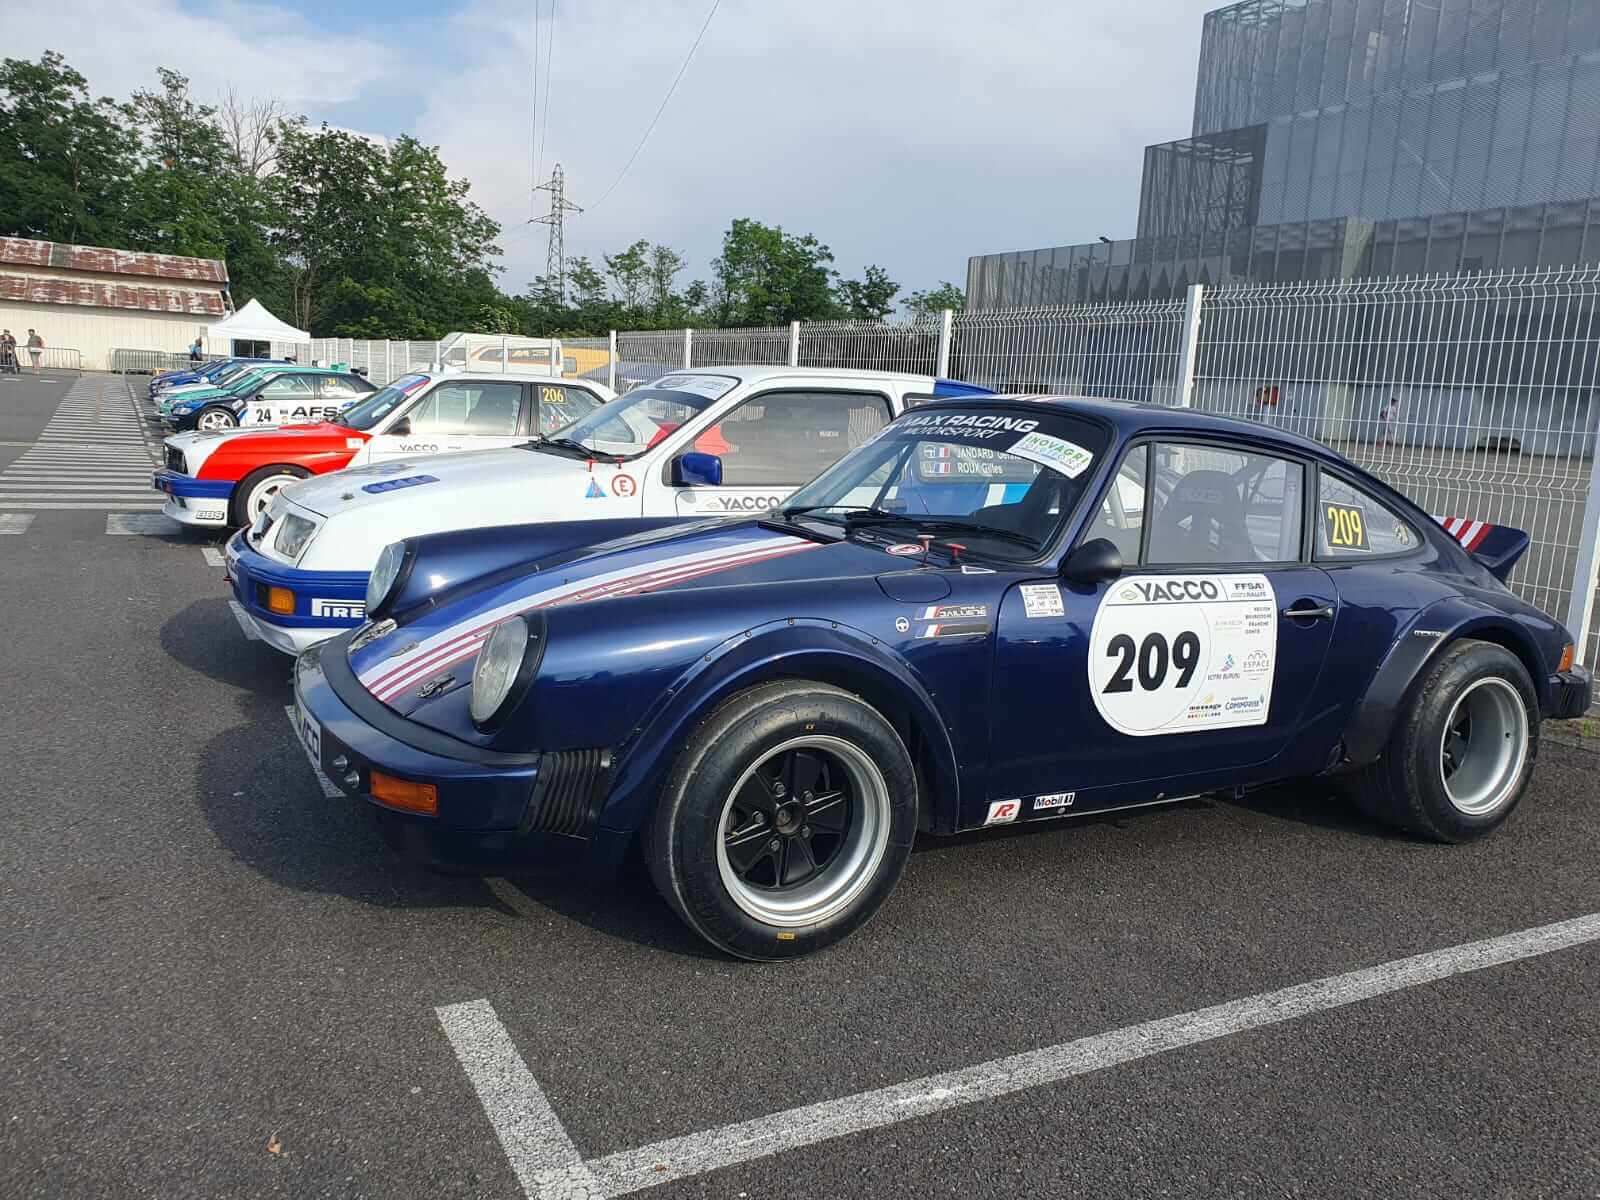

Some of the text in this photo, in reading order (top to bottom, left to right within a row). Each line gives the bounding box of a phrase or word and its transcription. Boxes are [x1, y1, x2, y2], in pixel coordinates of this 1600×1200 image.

[542, 387, 564, 403] 206
[255, 407, 272, 422] 24
[291, 406, 337, 417] AFS
[944, 415, 1039, 433] RACING
[903, 427, 1006, 439] MOTORSPORT
[399, 443, 439, 452] YACCO
[1024, 435, 1089, 464] INOVAGRI
[957, 462, 1003, 475] ROUX Gilles
[619, 479, 629, 492] E
[718, 496, 780, 511] YACCO
[195, 510, 225, 520] BBS
[1327, 506, 1362, 547] 209
[1134, 580, 1218, 602] YACCO
[1234, 582, 1262, 591] FFSA
[311, 597, 366, 618] PIRE
[1102, 631, 1200, 694] 209
[1243, 660, 1270, 669] ESPACE
[1035, 794, 1072, 808] Mobil 1
